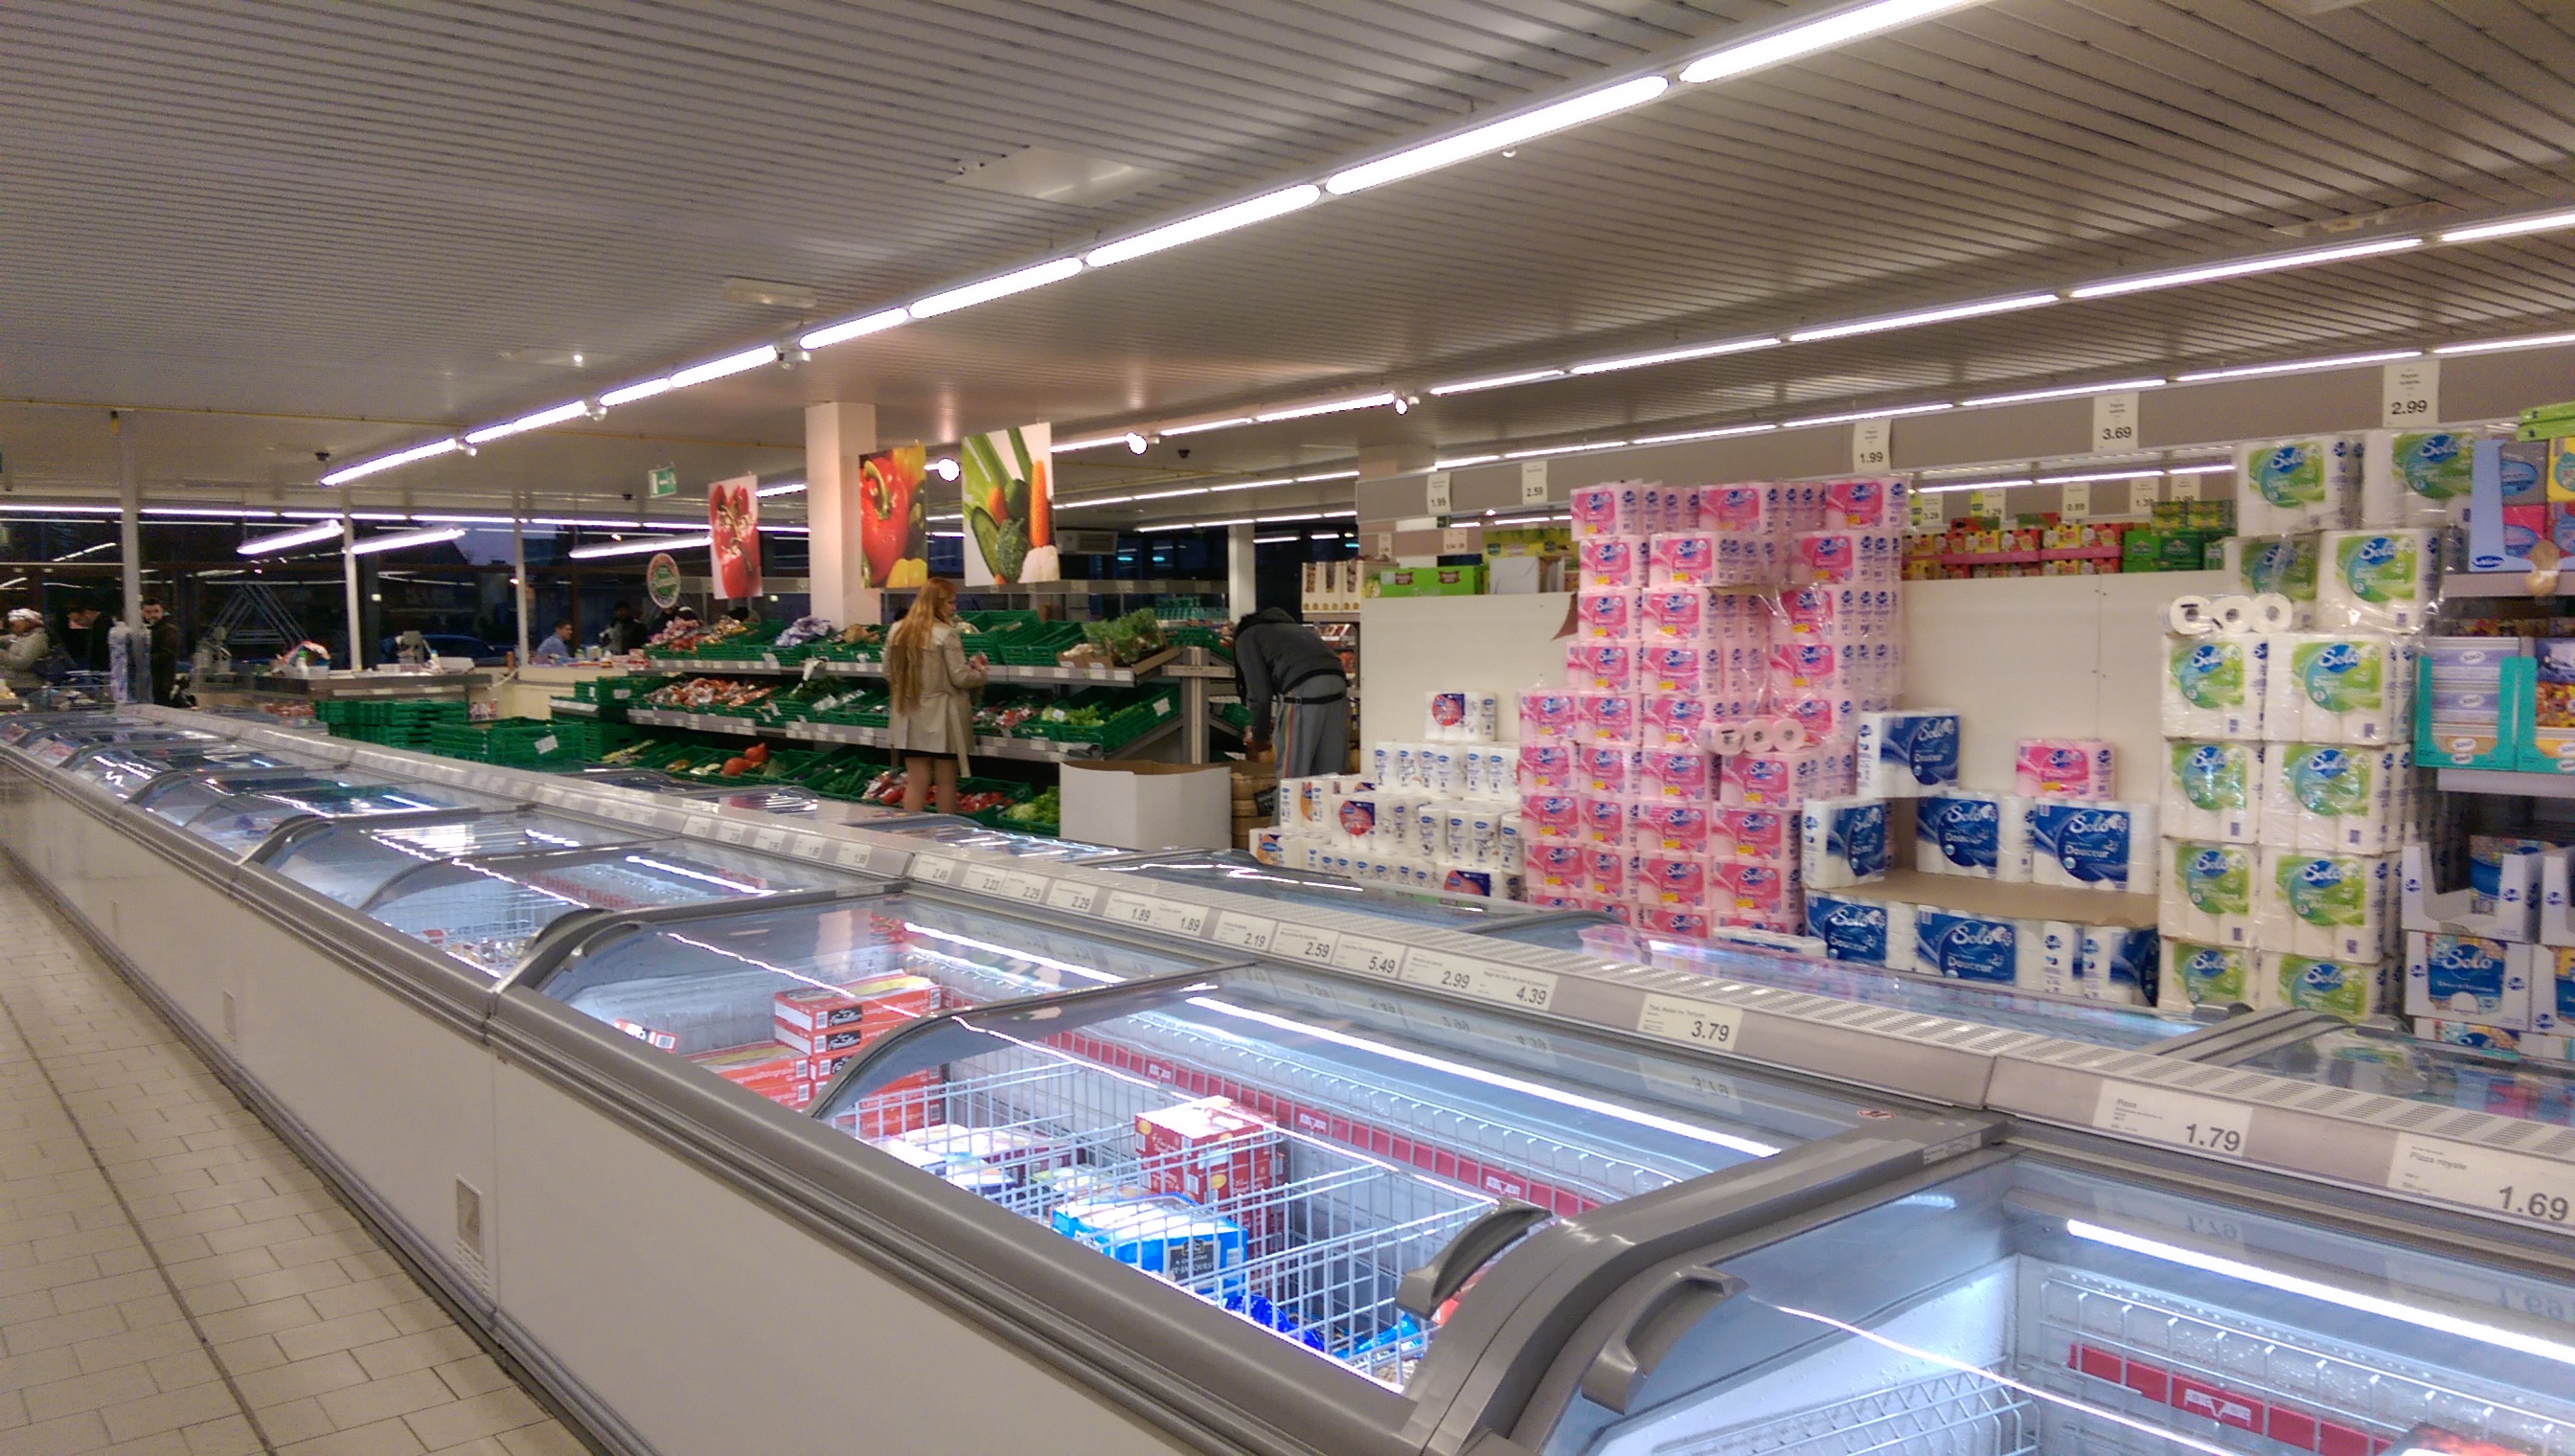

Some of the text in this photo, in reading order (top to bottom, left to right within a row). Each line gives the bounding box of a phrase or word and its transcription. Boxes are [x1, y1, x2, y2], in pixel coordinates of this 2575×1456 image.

[2391, 399, 2428, 416] 2.99
[2102, 426, 2132, 441] 3.69
[1859, 450, 1883, 466] 1.99
[1946, 805, 1982, 824] Solo
[2069, 813, 2109, 834] Solo
[2064, 844, 2109, 858] Douceur
[1131, 908, 1151, 923] 1.89
[1179, 918, 1201, 932] 1.89
[1951, 923, 1995, 945] Solo
[1243, 932, 1266, 948] 2.19
[1304, 942, 1331, 959] 2.59
[2442, 948, 2494, 970] Solo
[1368, 956, 1397, 974] 5.49
[1440, 969, 1471, 990] 2.99
[1515, 986, 1548, 1006] 4.39
[1691, 1020, 1730, 1042] 3.79
[2185, 1122, 2241, 1152] 1.79
[2498, 1185, 2570, 1222] 1.69
